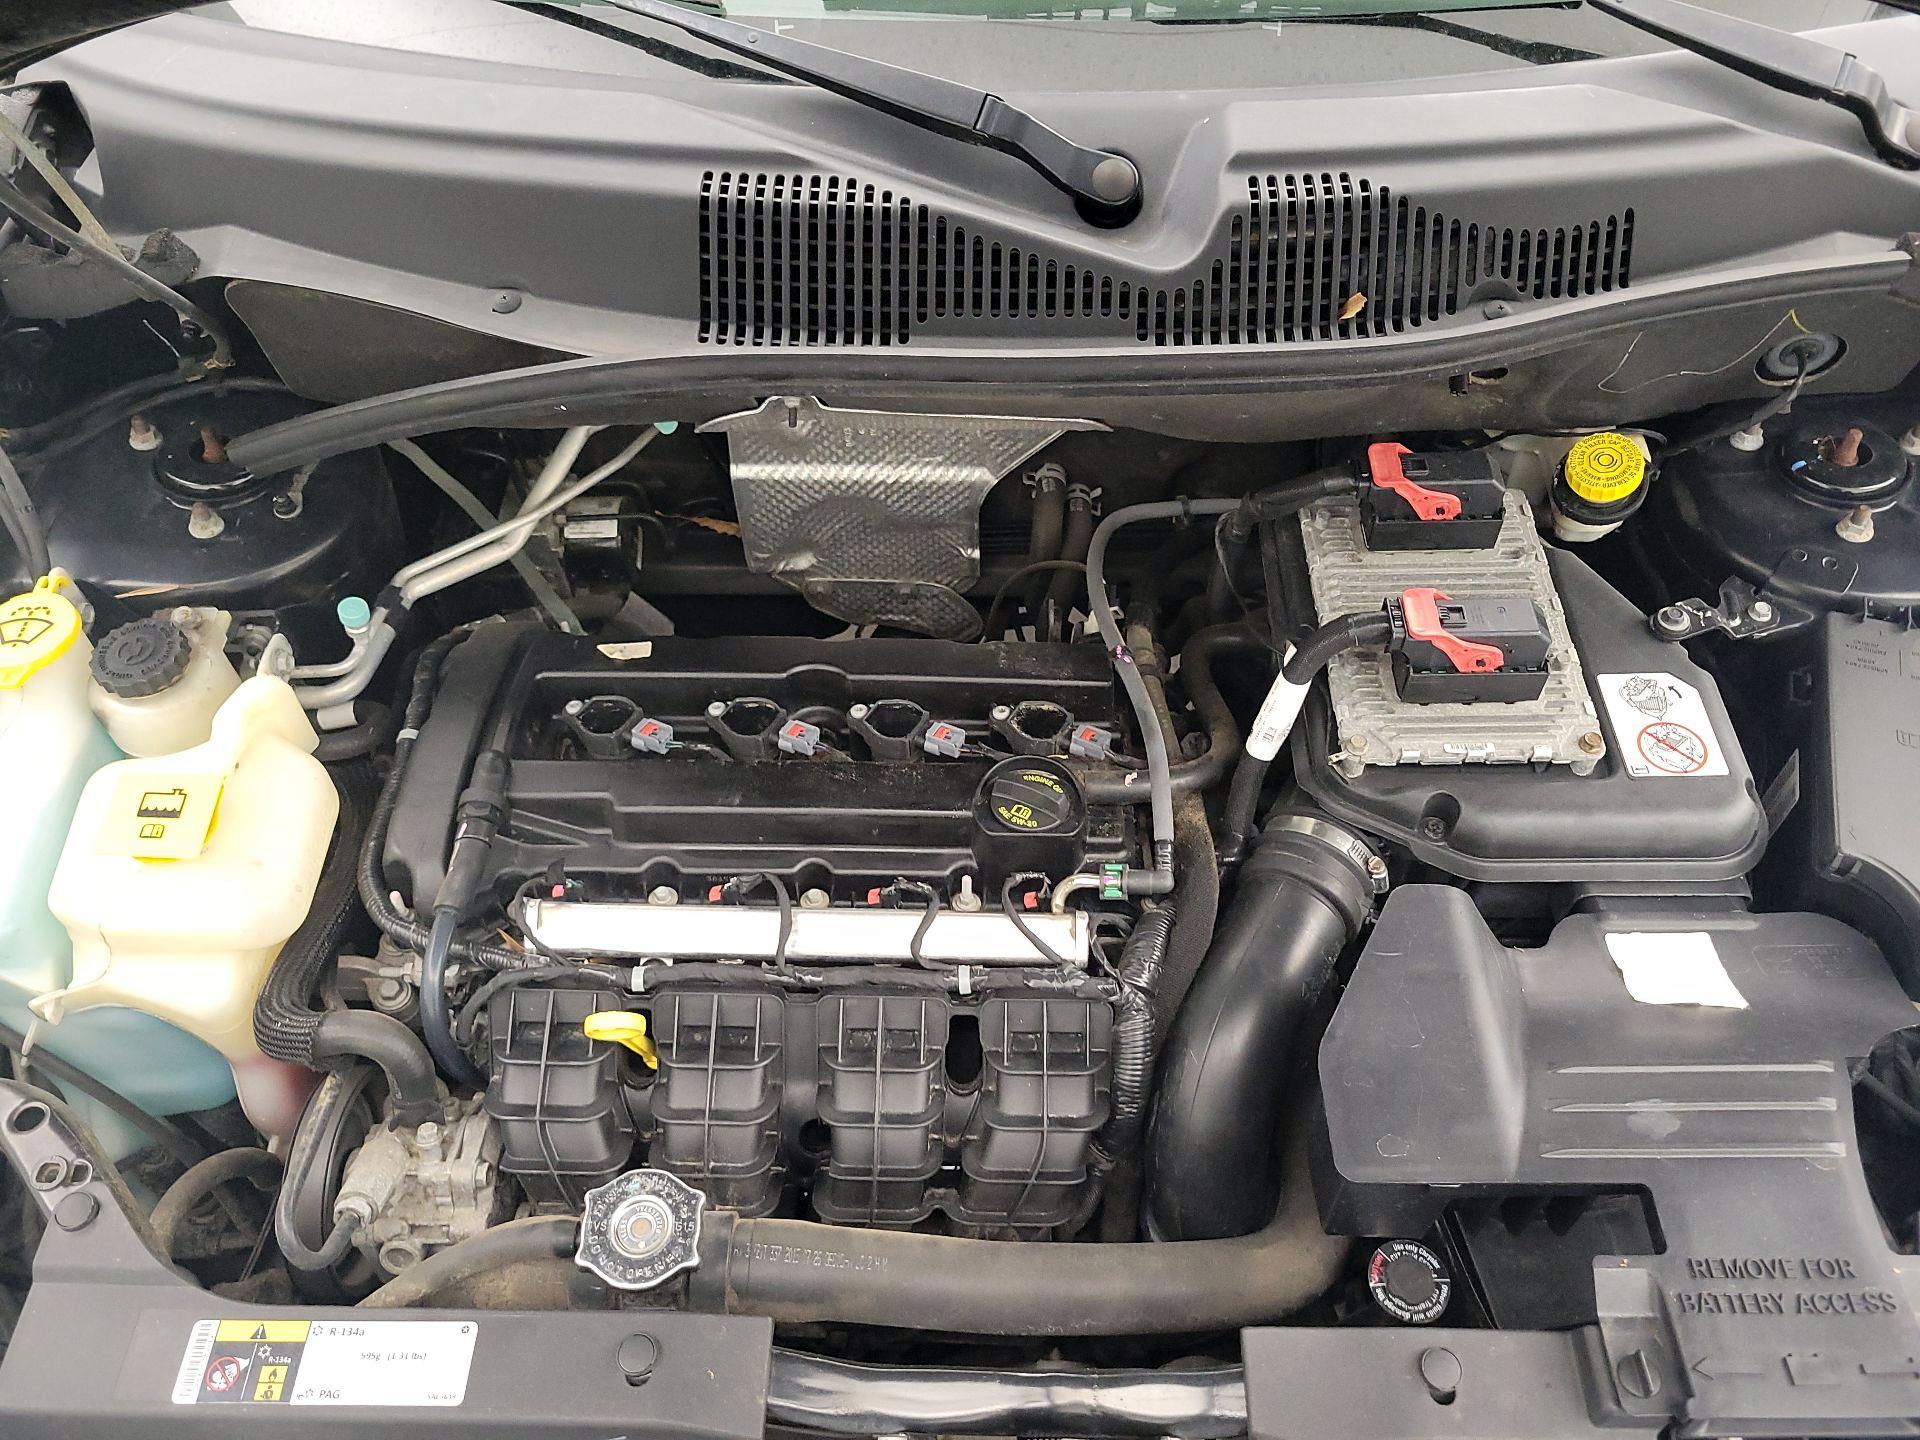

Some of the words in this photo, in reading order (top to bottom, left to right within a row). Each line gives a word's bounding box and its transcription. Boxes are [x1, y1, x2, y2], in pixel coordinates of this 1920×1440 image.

[998, 806, 1013, 820] SAE
[1393, 1243, 1404, 1251] Use
[1405, 1243, 1419, 1254] only
[1418, 1247, 1441, 1269] Chrysler
[1687, 1257, 1797, 1280] REMOVE
[1799, 1257, 1858, 1280] FOR
[1375, 1288, 1386, 1301] the
[1439, 1284, 1449, 1304] Other
[1384, 1299, 1411, 1320] damage
[1678, 1292, 1785, 1314] BATTERY
[1795, 1292, 1898, 1314] ACCESS
[1412, 1312, 1426, 1322] will
[329, 1326, 366, 1337] R-134a
[268, 1355, 292, 1365] R-134a
[319, 1389, 341, 1400] PAG
